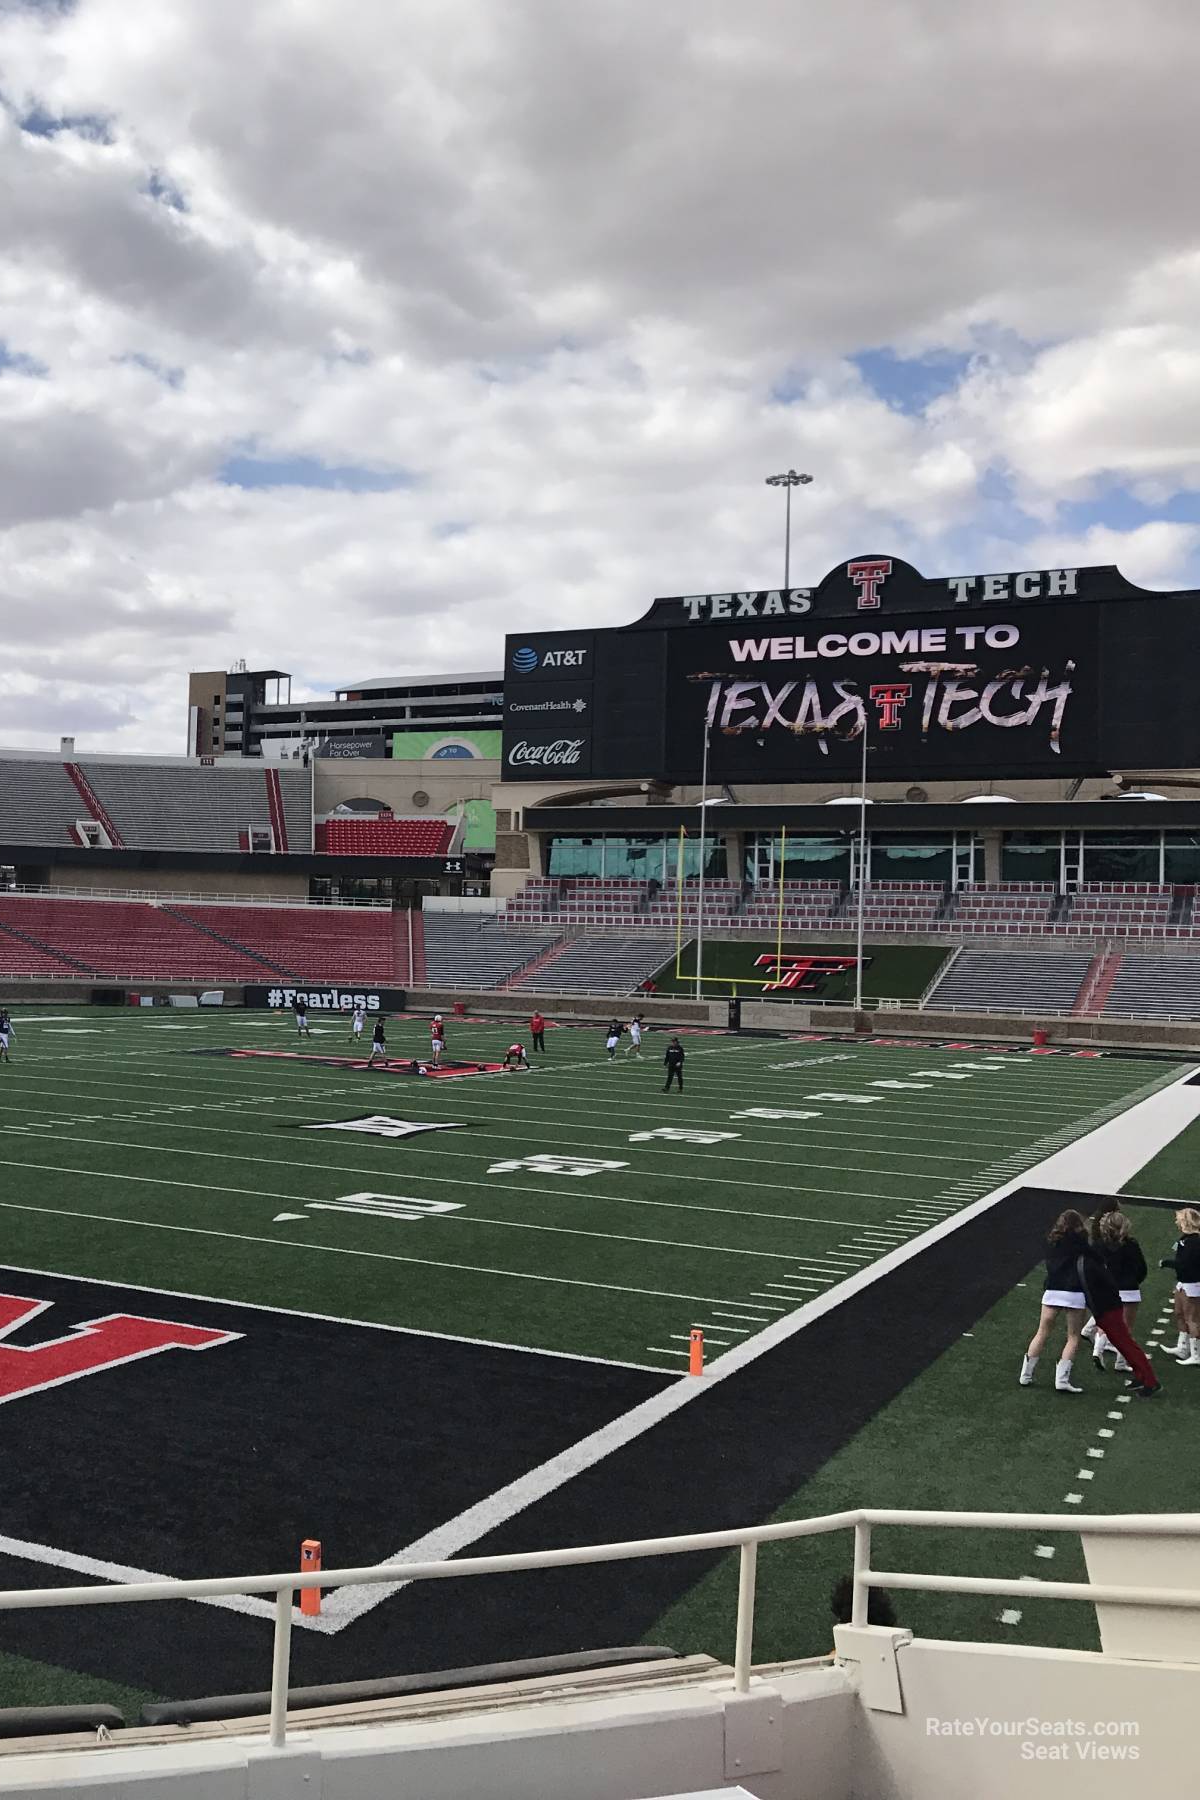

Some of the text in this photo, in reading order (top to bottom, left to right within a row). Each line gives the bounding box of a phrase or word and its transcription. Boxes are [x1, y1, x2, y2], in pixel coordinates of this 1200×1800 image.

[683, 589, 812, 621] TEXAS
[948, 569, 1079, 604] TECH
[729, 624, 1020, 662] WELCOME TO
[542, 650, 587, 667] AT&T
[687, 671, 867, 755] TEXAS
[898, 659, 1077, 755] TECH
[329, 741, 373, 750] Horsepower
[267, 989, 380, 1010] #Fearless
